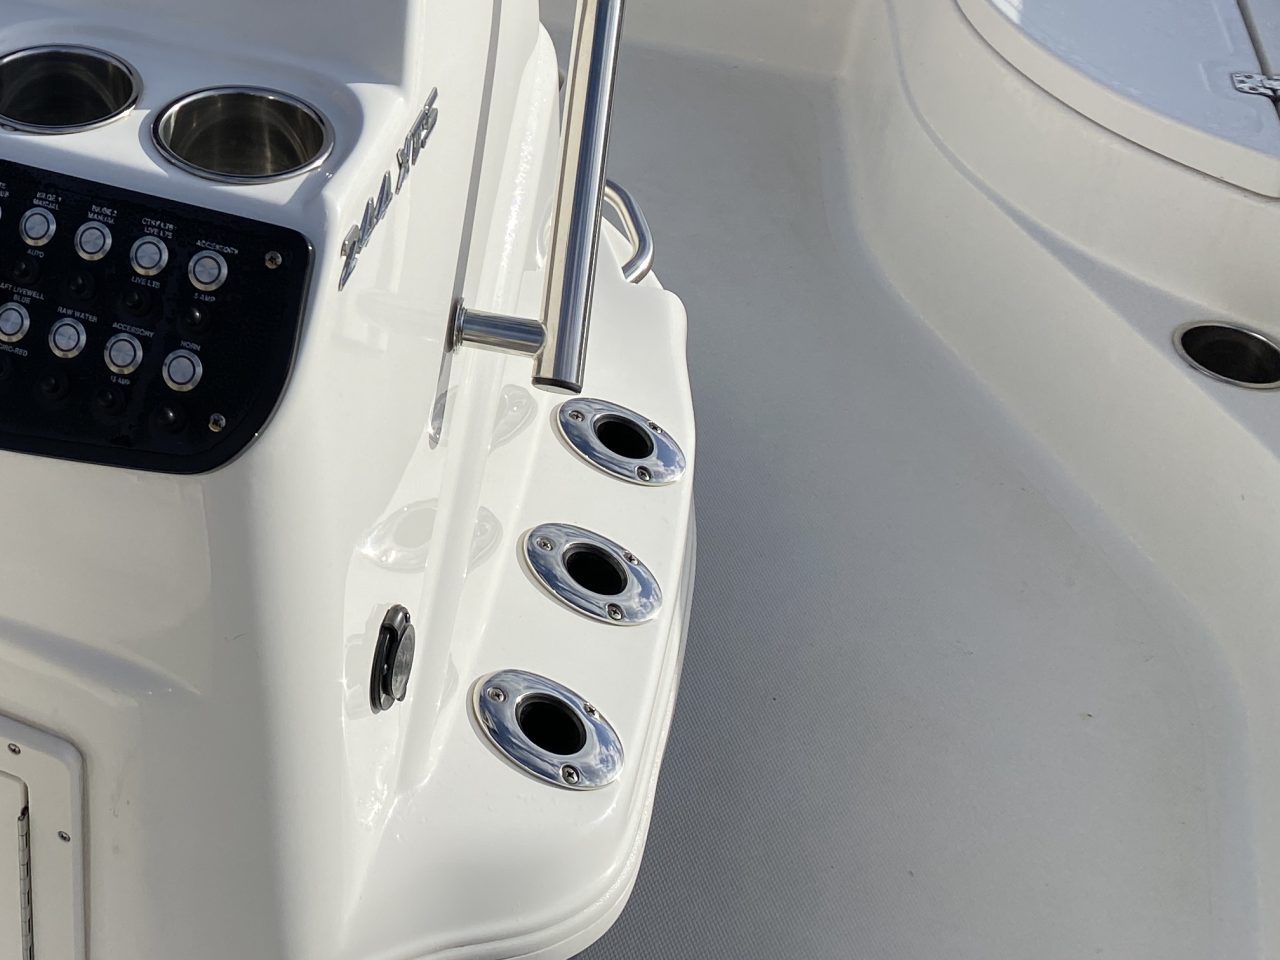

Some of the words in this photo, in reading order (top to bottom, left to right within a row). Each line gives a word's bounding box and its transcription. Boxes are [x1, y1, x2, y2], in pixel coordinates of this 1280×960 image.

[27, 248, 45, 259] AUTO
[0, 282, 12, 292] AFT
[13, 285, 45, 301] LIVEWELL
[13, 294, 31, 305] BLUE
[57, 306, 73, 316] RAW
[74, 309, 98, 323] WATER
[112, 321, 155, 338] ACCESSORY
[180, 340, 201, 351] HORN
